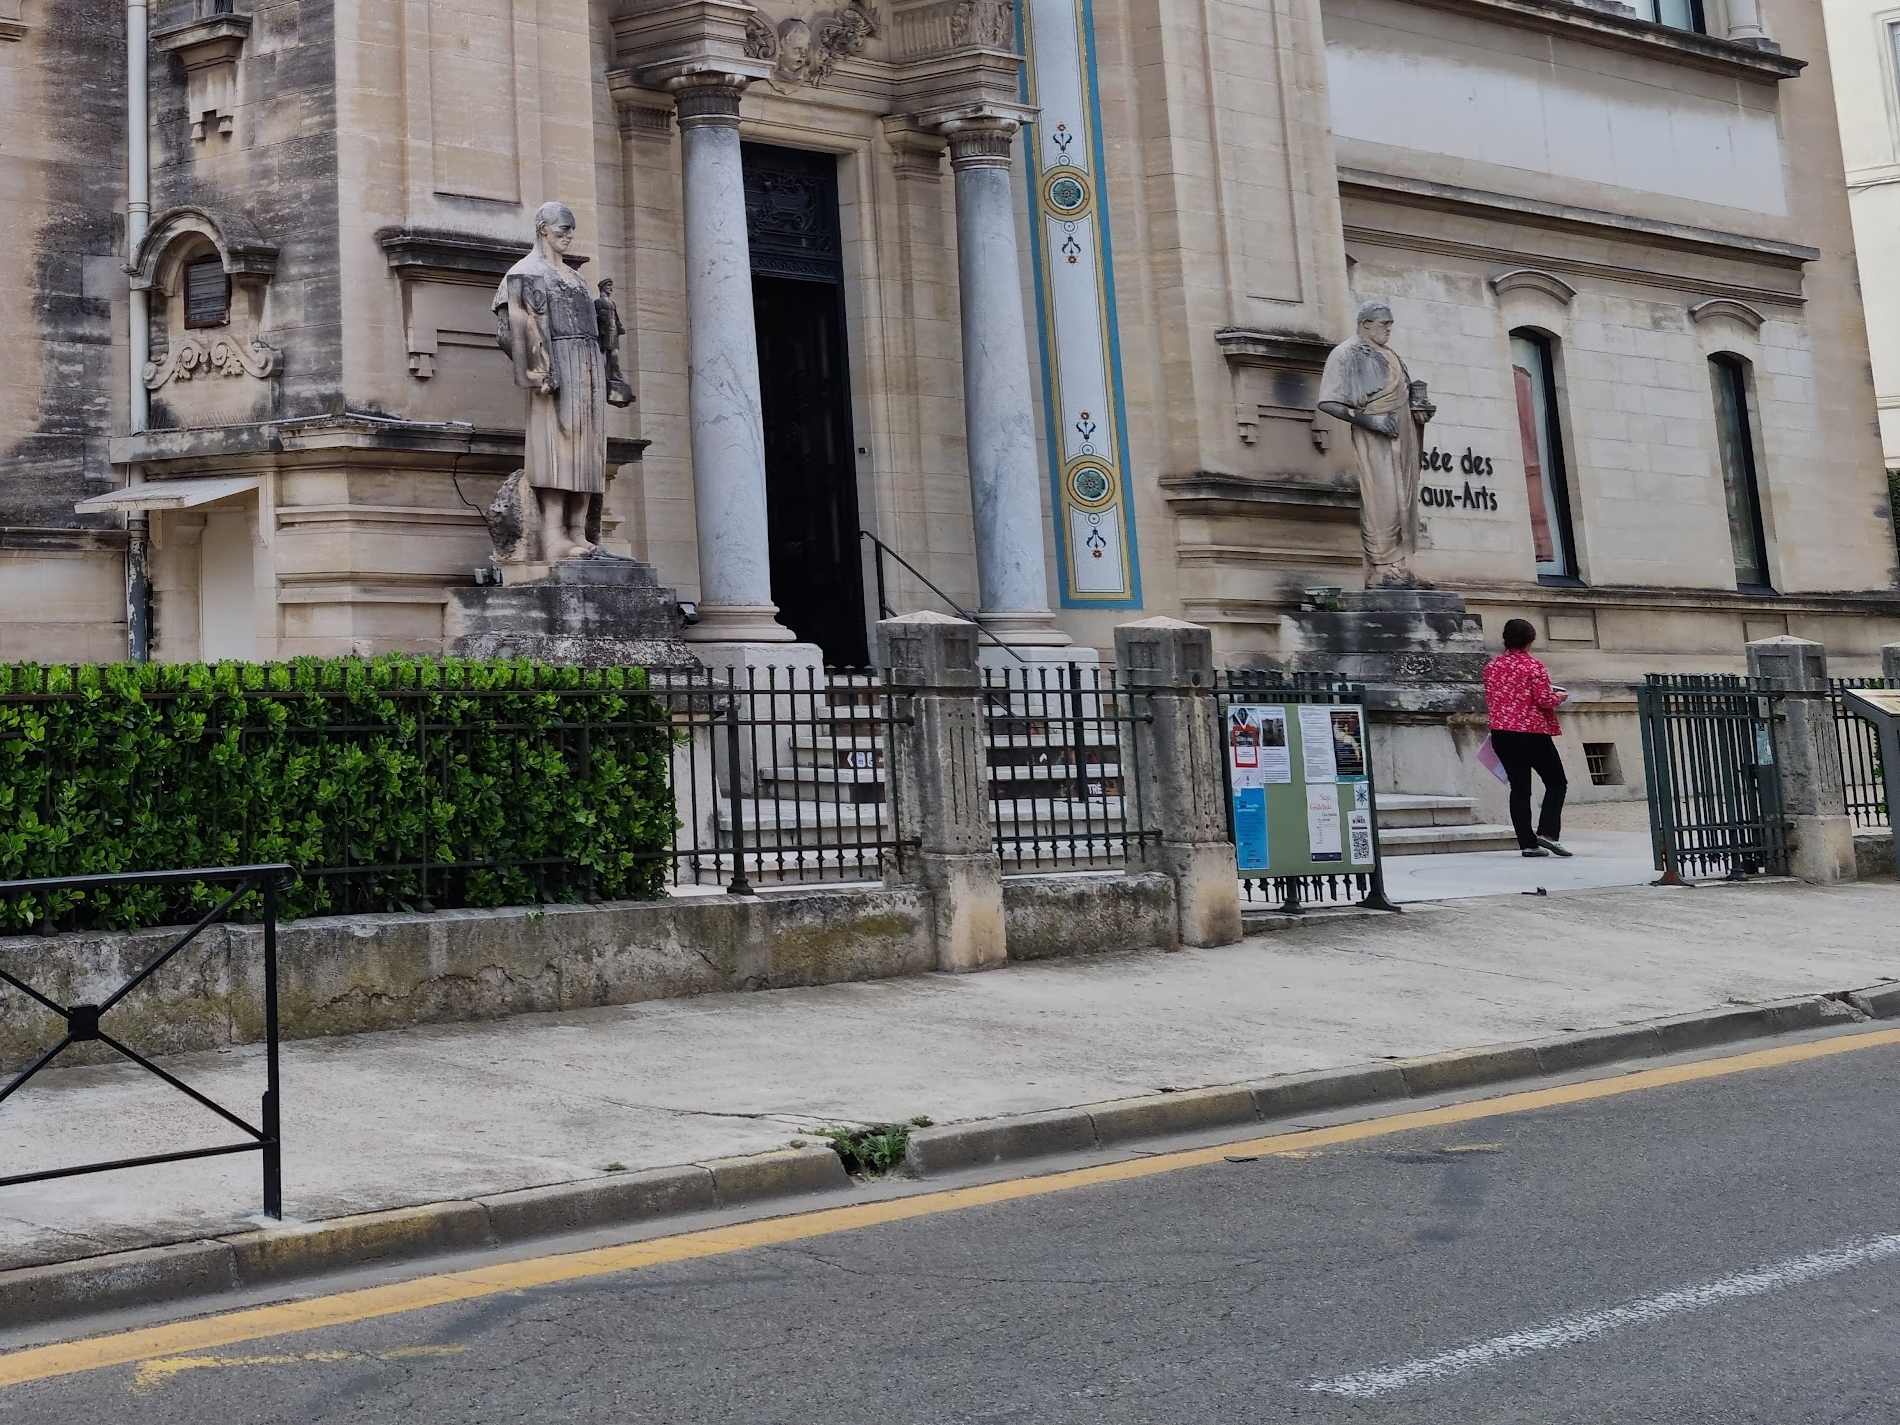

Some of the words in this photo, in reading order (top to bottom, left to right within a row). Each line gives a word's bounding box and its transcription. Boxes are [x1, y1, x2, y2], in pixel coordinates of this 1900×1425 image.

[1421, 446, 1454, 473] sée
[1461, 446, 1494, 476] des
[1419, 481, 1498, 511] aux-Arts
